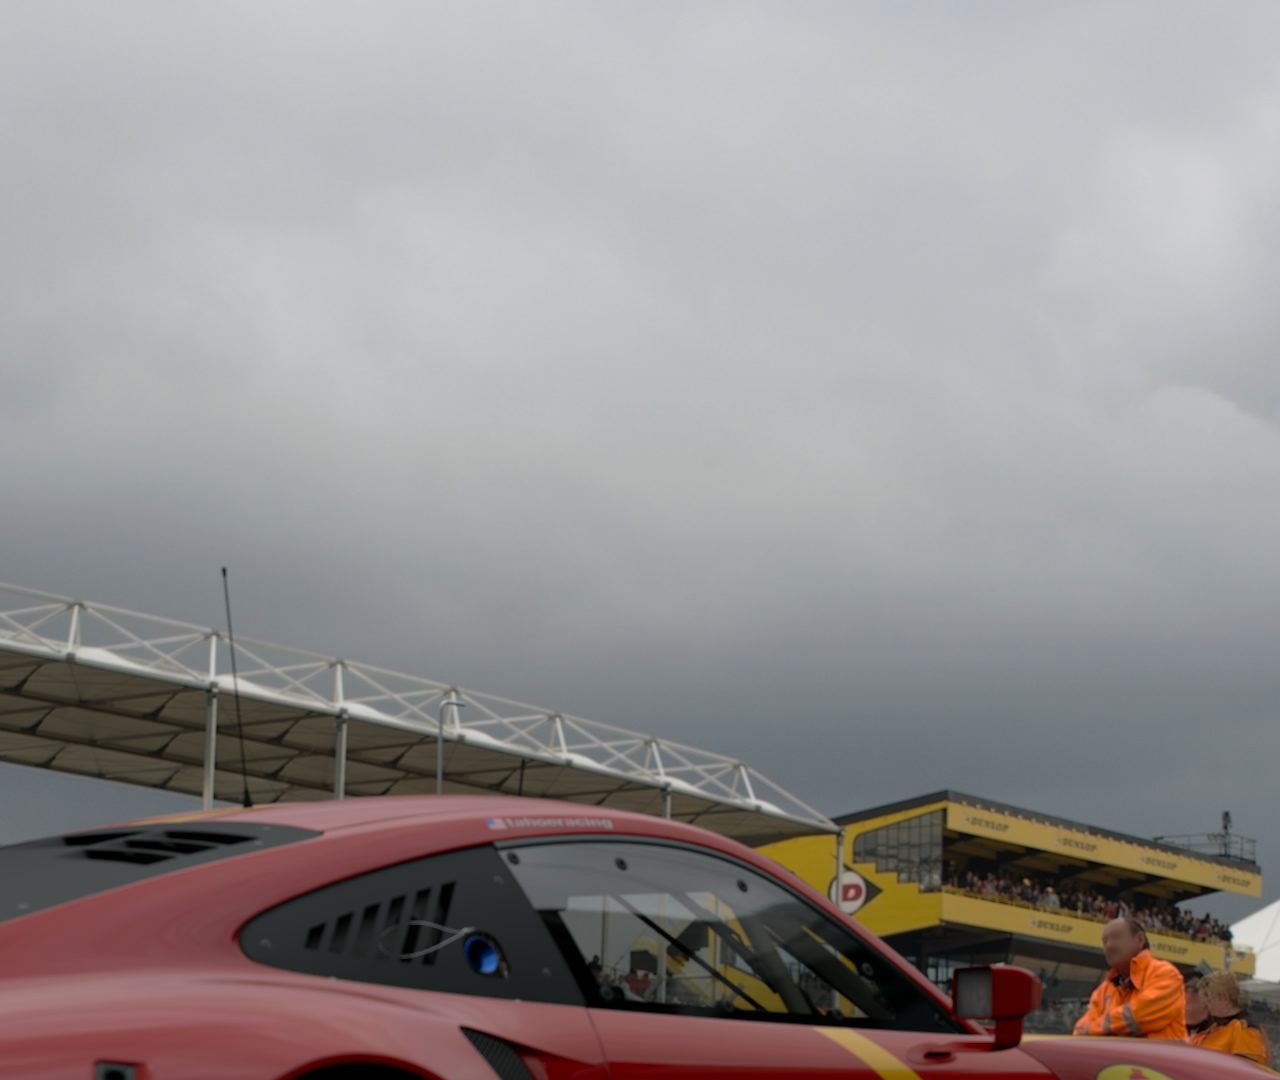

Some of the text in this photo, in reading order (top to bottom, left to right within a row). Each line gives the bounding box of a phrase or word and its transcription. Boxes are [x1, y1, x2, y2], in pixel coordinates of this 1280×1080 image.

[971, 816, 1009, 832] DUNLOP
[1062, 837, 1097, 852] DUNLOP
[1037, 919, 1073, 934] DUNLOP
